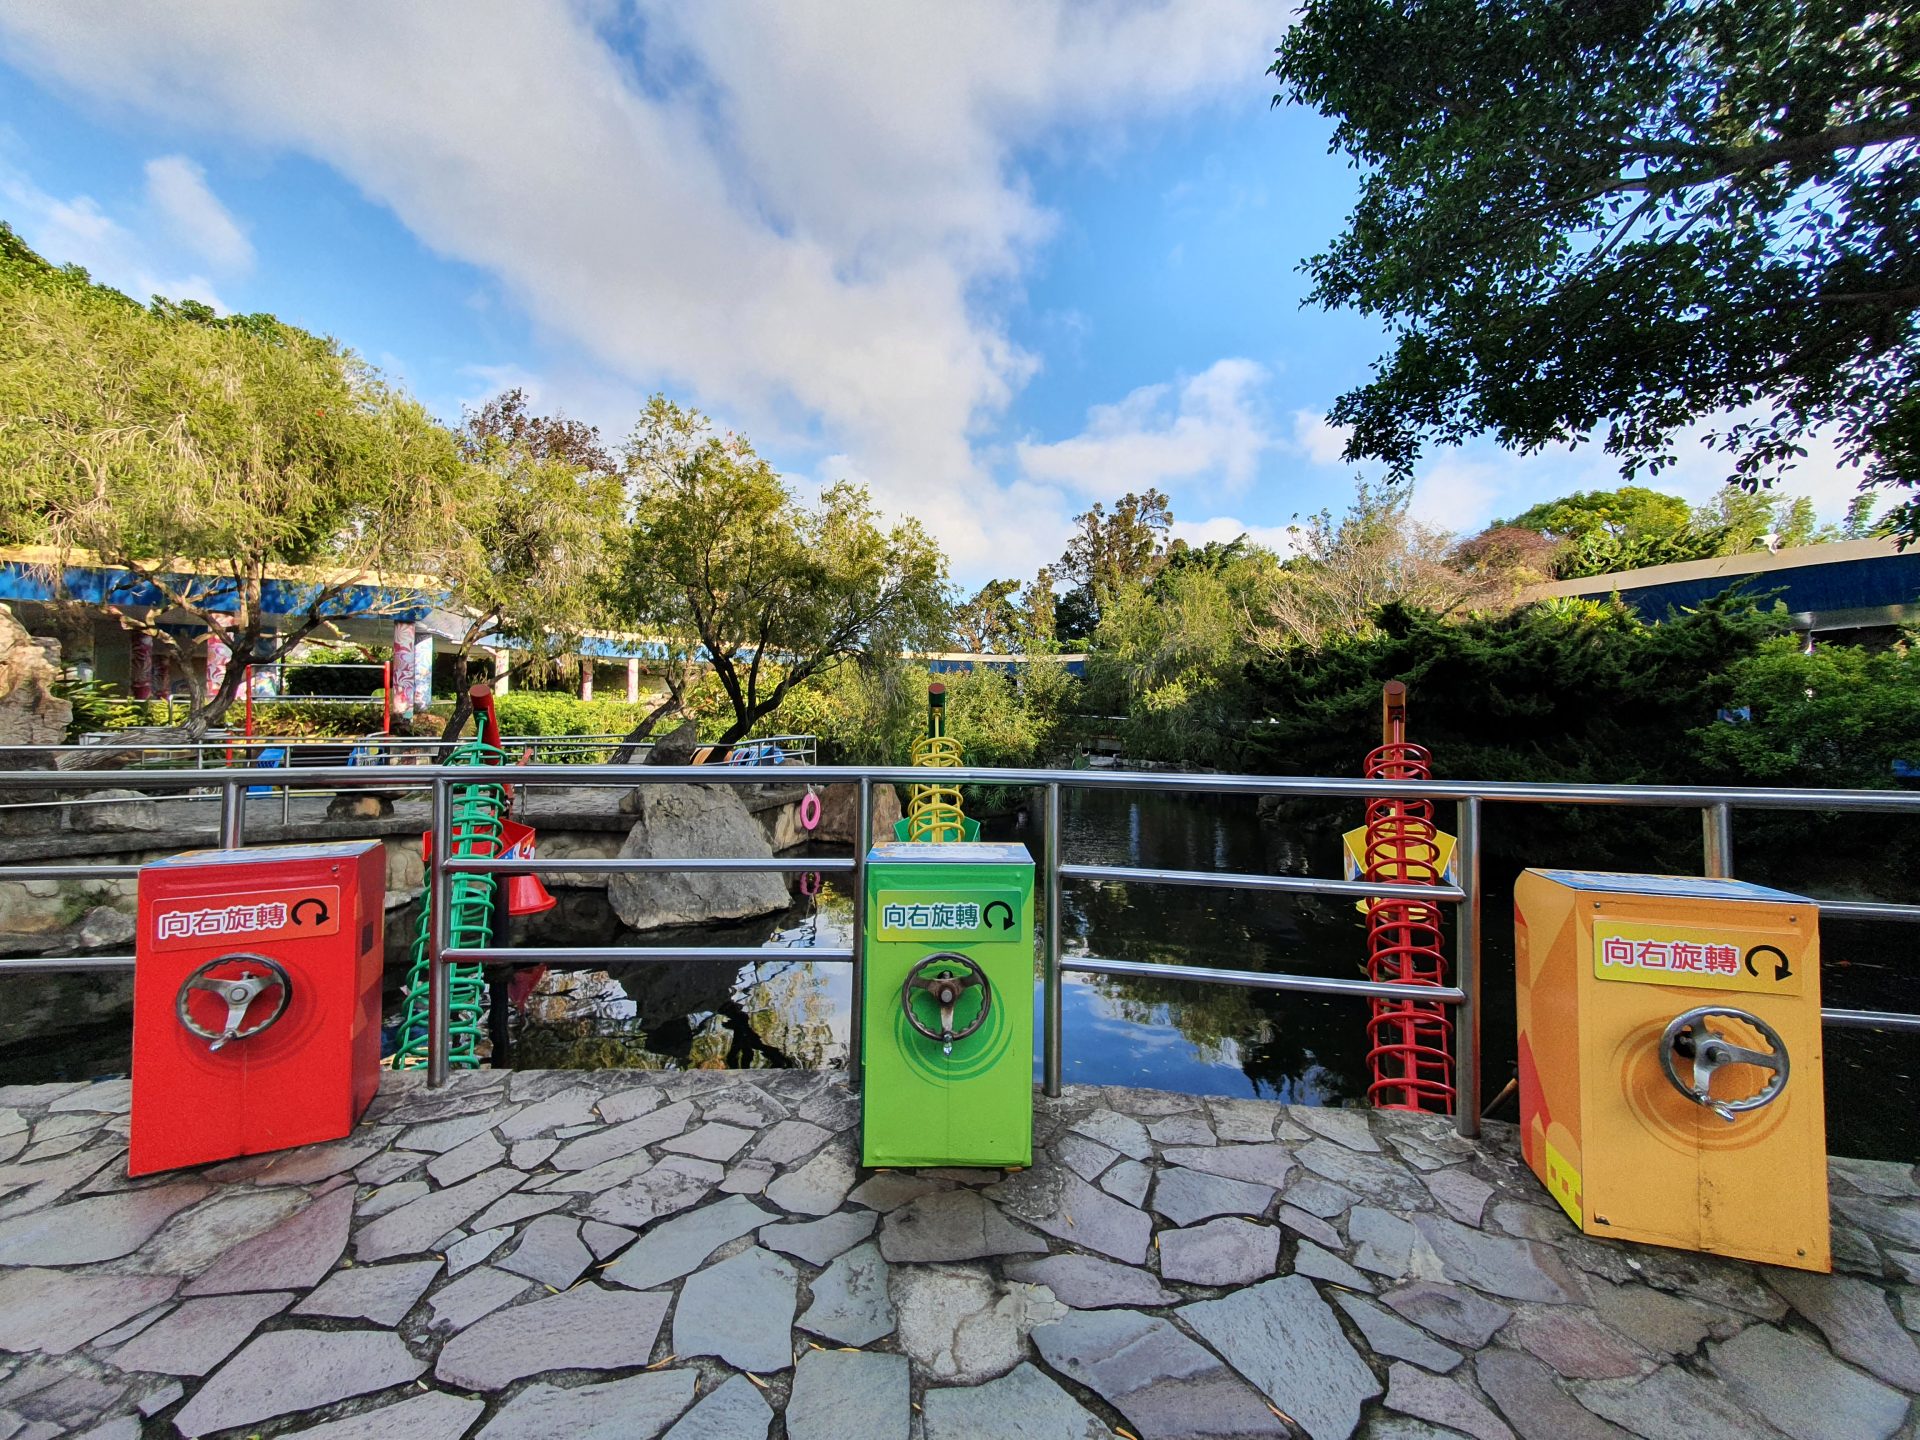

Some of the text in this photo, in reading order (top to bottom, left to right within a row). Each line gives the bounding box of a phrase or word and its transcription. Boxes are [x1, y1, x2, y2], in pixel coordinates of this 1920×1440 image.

[158, 904, 287, 939] 向右旋轉
[884, 903, 979, 928] 向右旋轉
[1603, 938, 1738, 974] 向右旋轉
